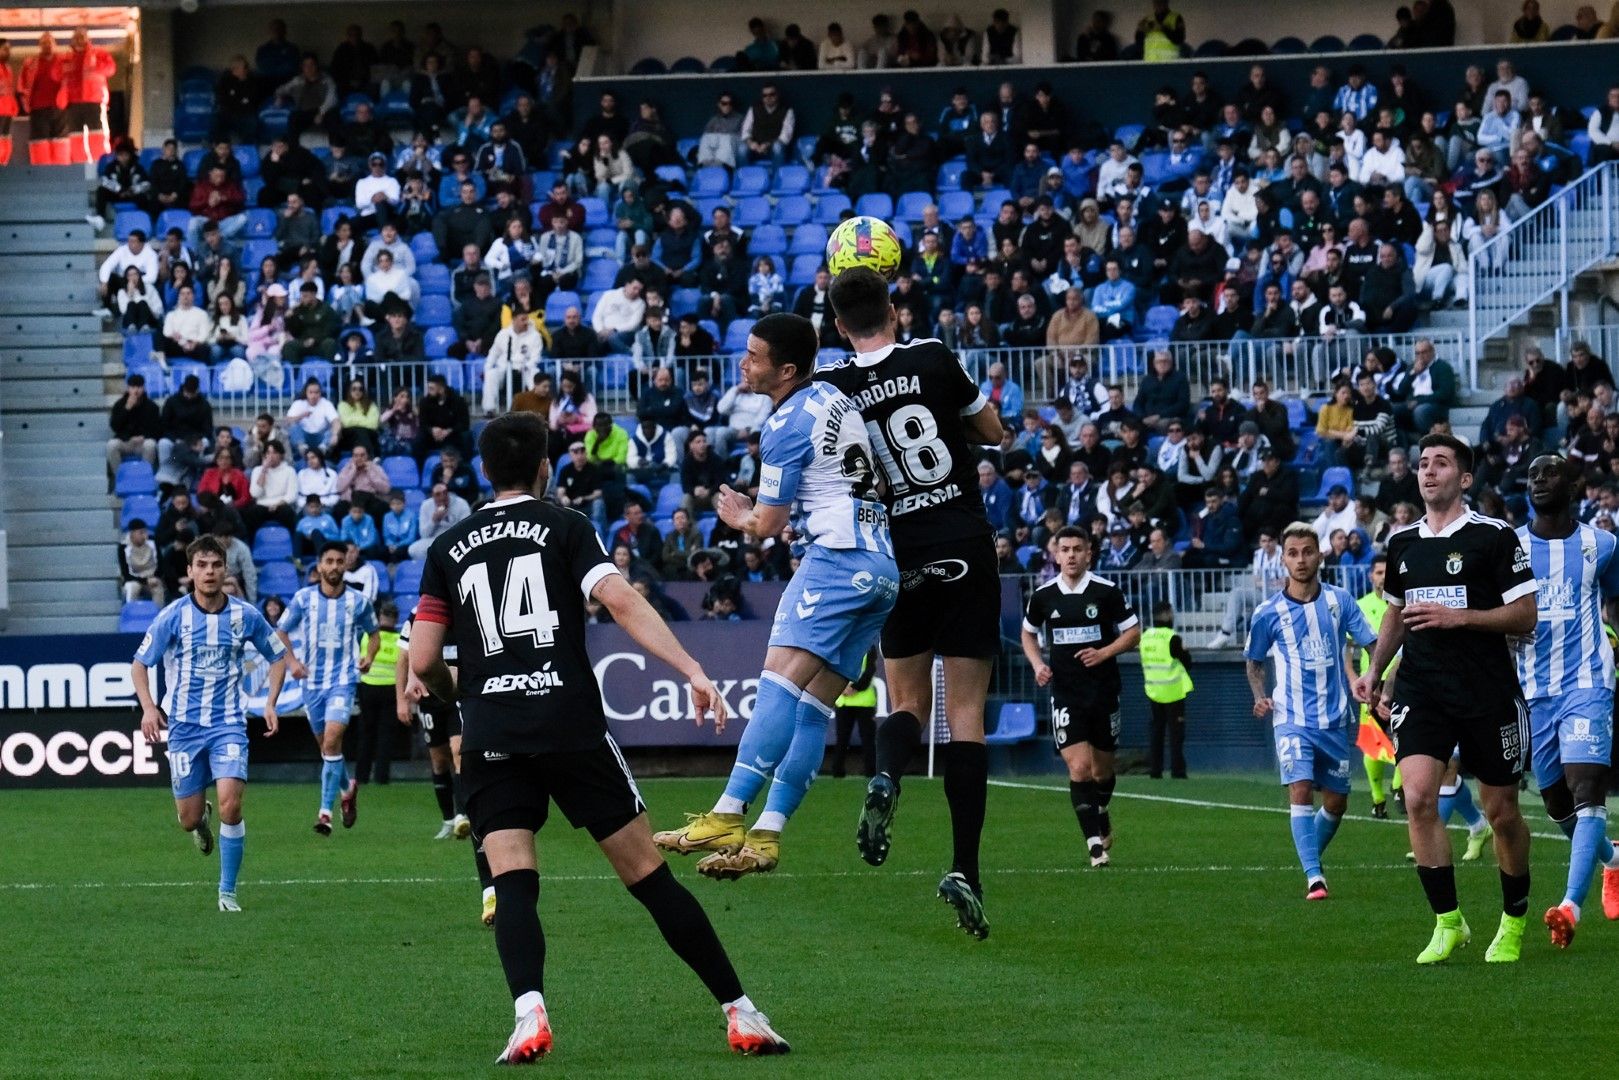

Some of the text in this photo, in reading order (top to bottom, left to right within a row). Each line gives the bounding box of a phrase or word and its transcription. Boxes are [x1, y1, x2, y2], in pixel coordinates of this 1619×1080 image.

[852, 376, 921, 412] ÓRDOBA
[866, 404, 952, 496] 18
[891, 483, 962, 516] BEROIL
[457, 551, 559, 657] 14
[1416, 599, 1466, 608] UROS
[1417, 587, 1465, 599] REALE
[481, 661, 563, 694] BEROIL
[1053, 707, 1070, 729] 16
[0, 730, 169, 776] OCCE
[171, 752, 191, 778] 10
[1279, 736, 1302, 761] 21
